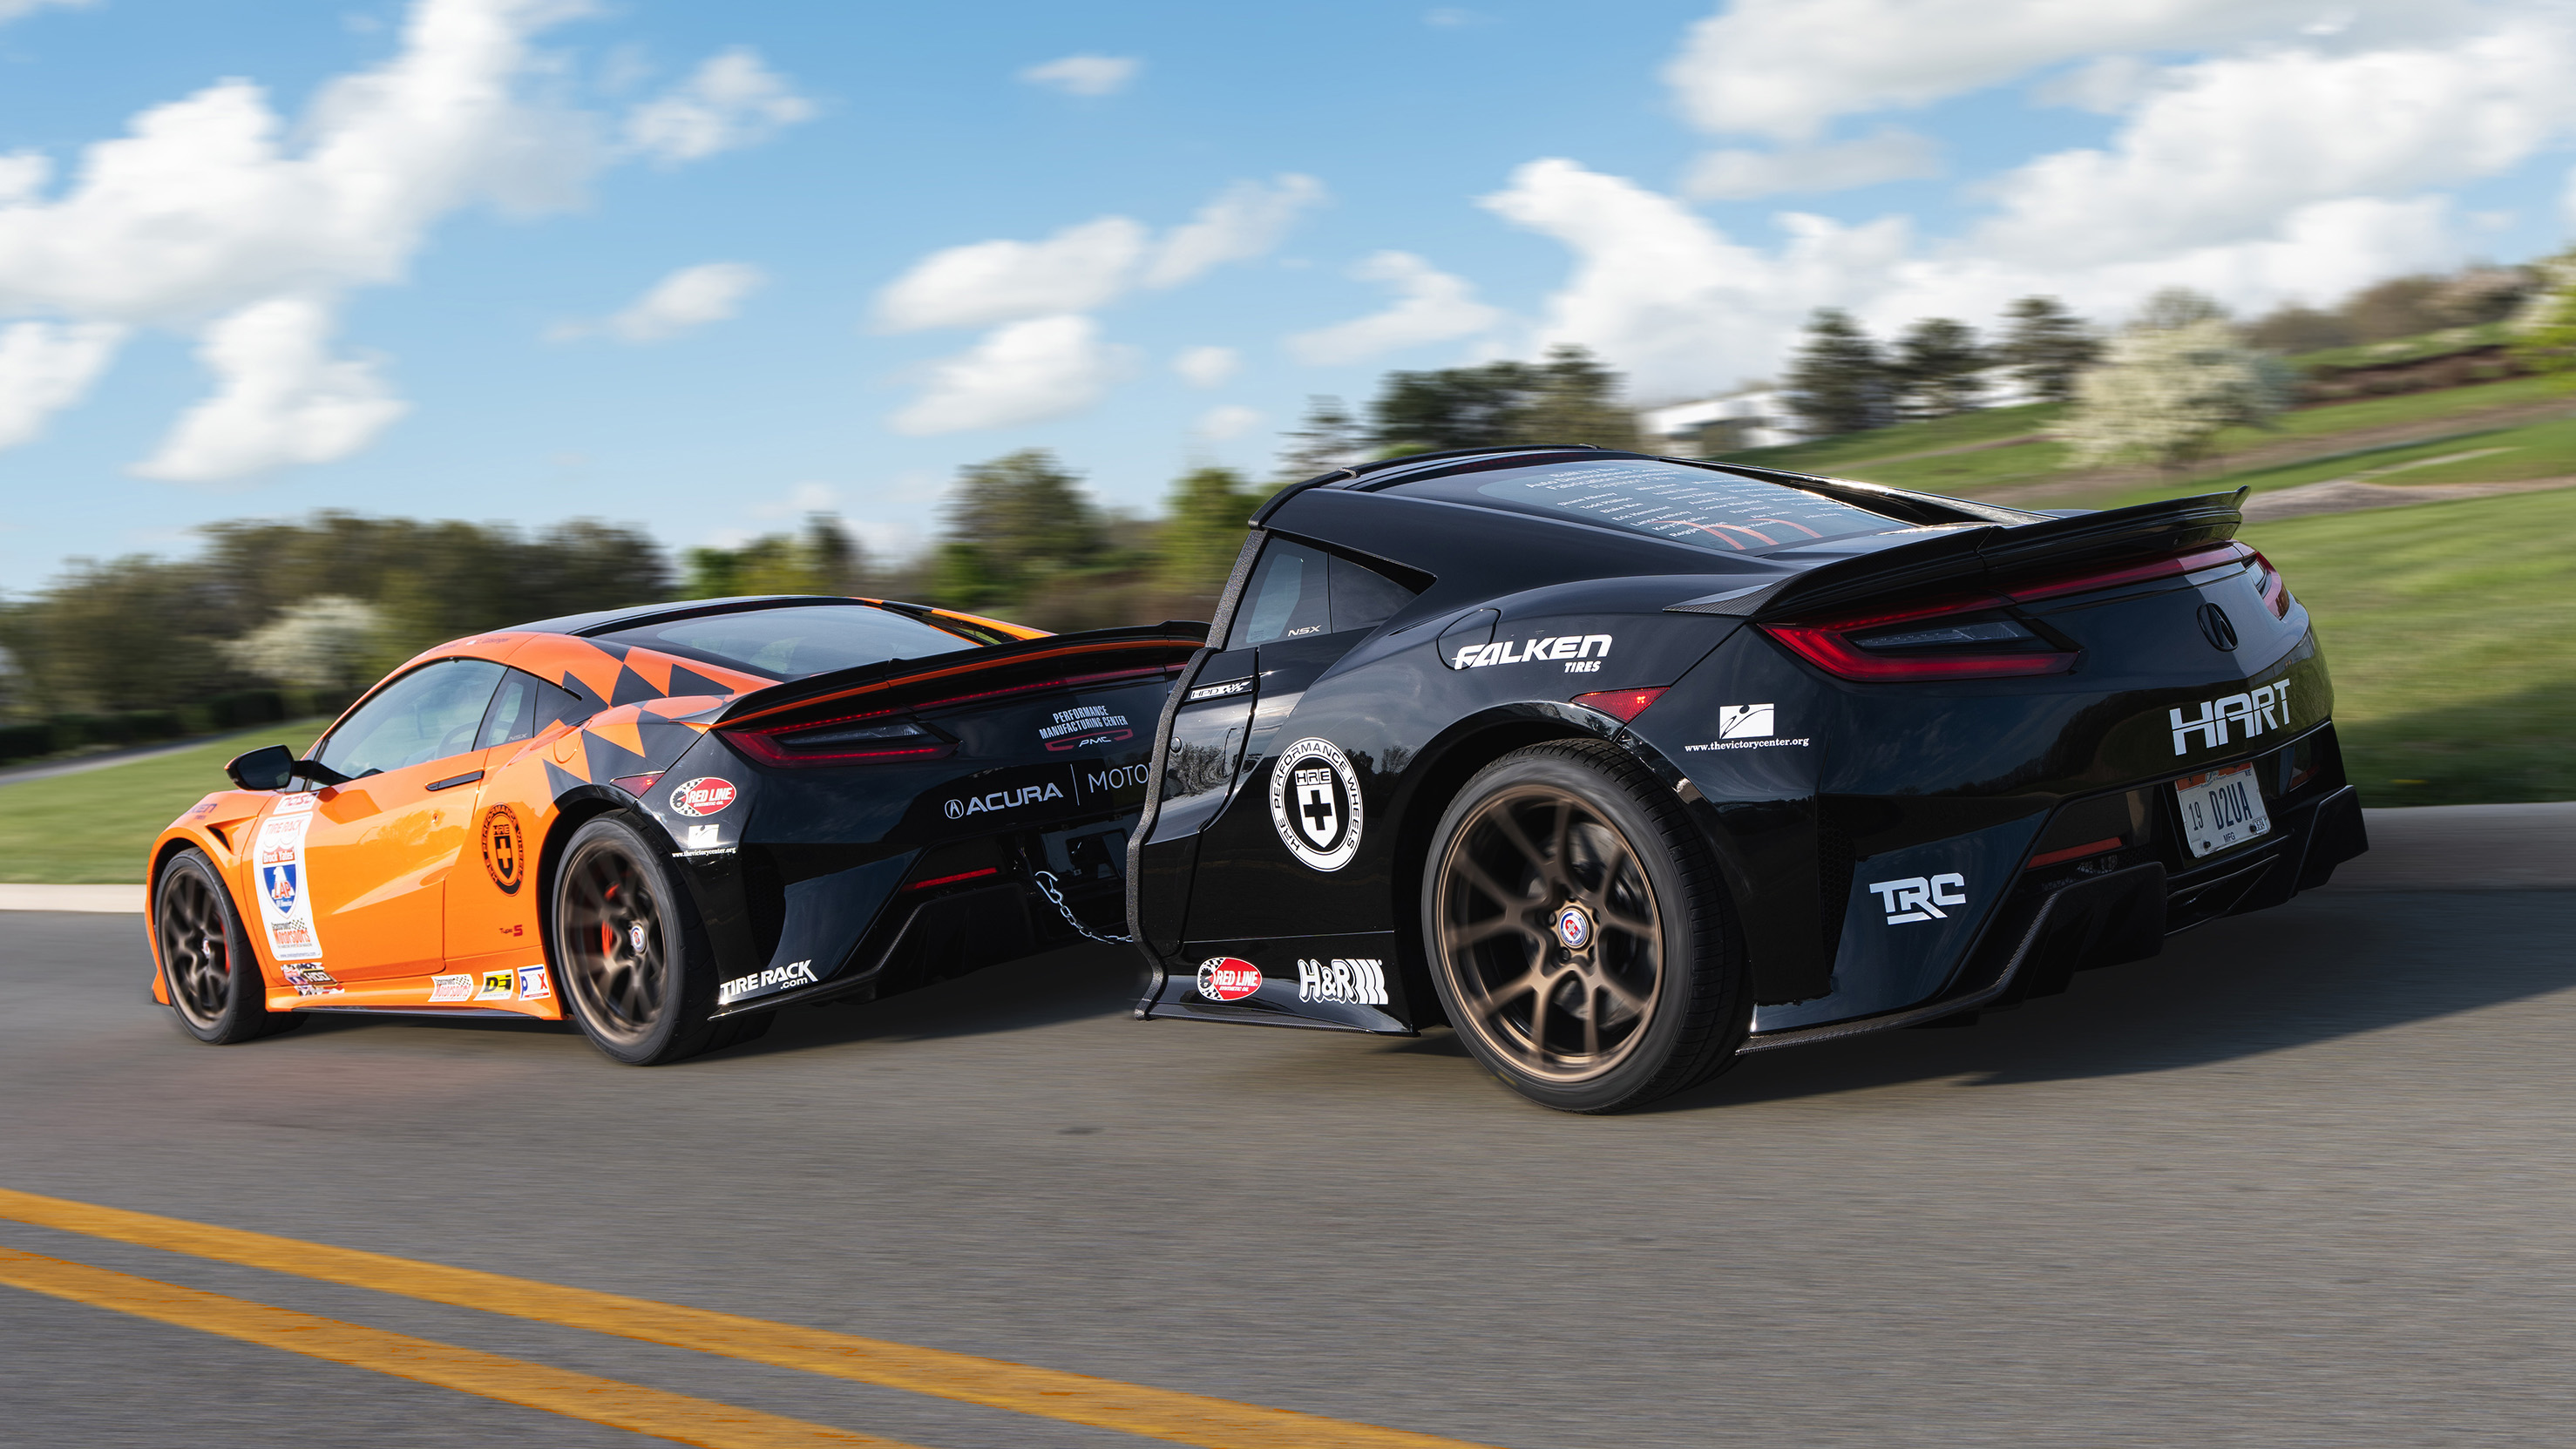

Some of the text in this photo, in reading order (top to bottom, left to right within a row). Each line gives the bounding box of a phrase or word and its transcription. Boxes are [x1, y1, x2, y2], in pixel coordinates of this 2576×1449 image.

[1287, 625, 1321, 637] NSX
[1452, 634, 1613, 670] FALKEN
[1564, 660, 1602, 674] TIRES
[1191, 687, 1219, 699] HPD
[1053, 705, 1108, 724] PERFORMANCE
[2169, 678, 2290, 755] HART
[1039, 715, 1129, 740] MANUFACTURING CENTER
[508, 733, 527, 741] NSX
[1078, 736, 1112, 748] PMC
[1685, 738, 1810, 752] www.thevictorycenter.org
[1296, 770, 1331, 783] HRE
[688, 789, 708, 803] RED
[966, 763, 1152, 816] ACURA MOTO
[1274, 742, 1359, 850] HRE PERFORMANCE WHEELS
[2188, 781, 2253, 831] 19 D2UA
[266, 822, 284, 835] TIRE
[492, 824, 510, 836] HRE
[2223, 832, 2236, 843] MFG
[263, 851, 278, 863] Brock
[672, 847, 736, 857] www.thevictorycenter.org
[274, 881, 291, 898] LAP
[1869, 872, 1966, 922] TRC
[273, 929, 311, 945] Motorsports
[513, 924, 523, 938] S
[720, 959, 818, 1000] TIRE RACK
[780, 977, 808, 989] .com
[1216, 971, 1235, 986] RED
[1298, 958, 1359, 1004] H&R
